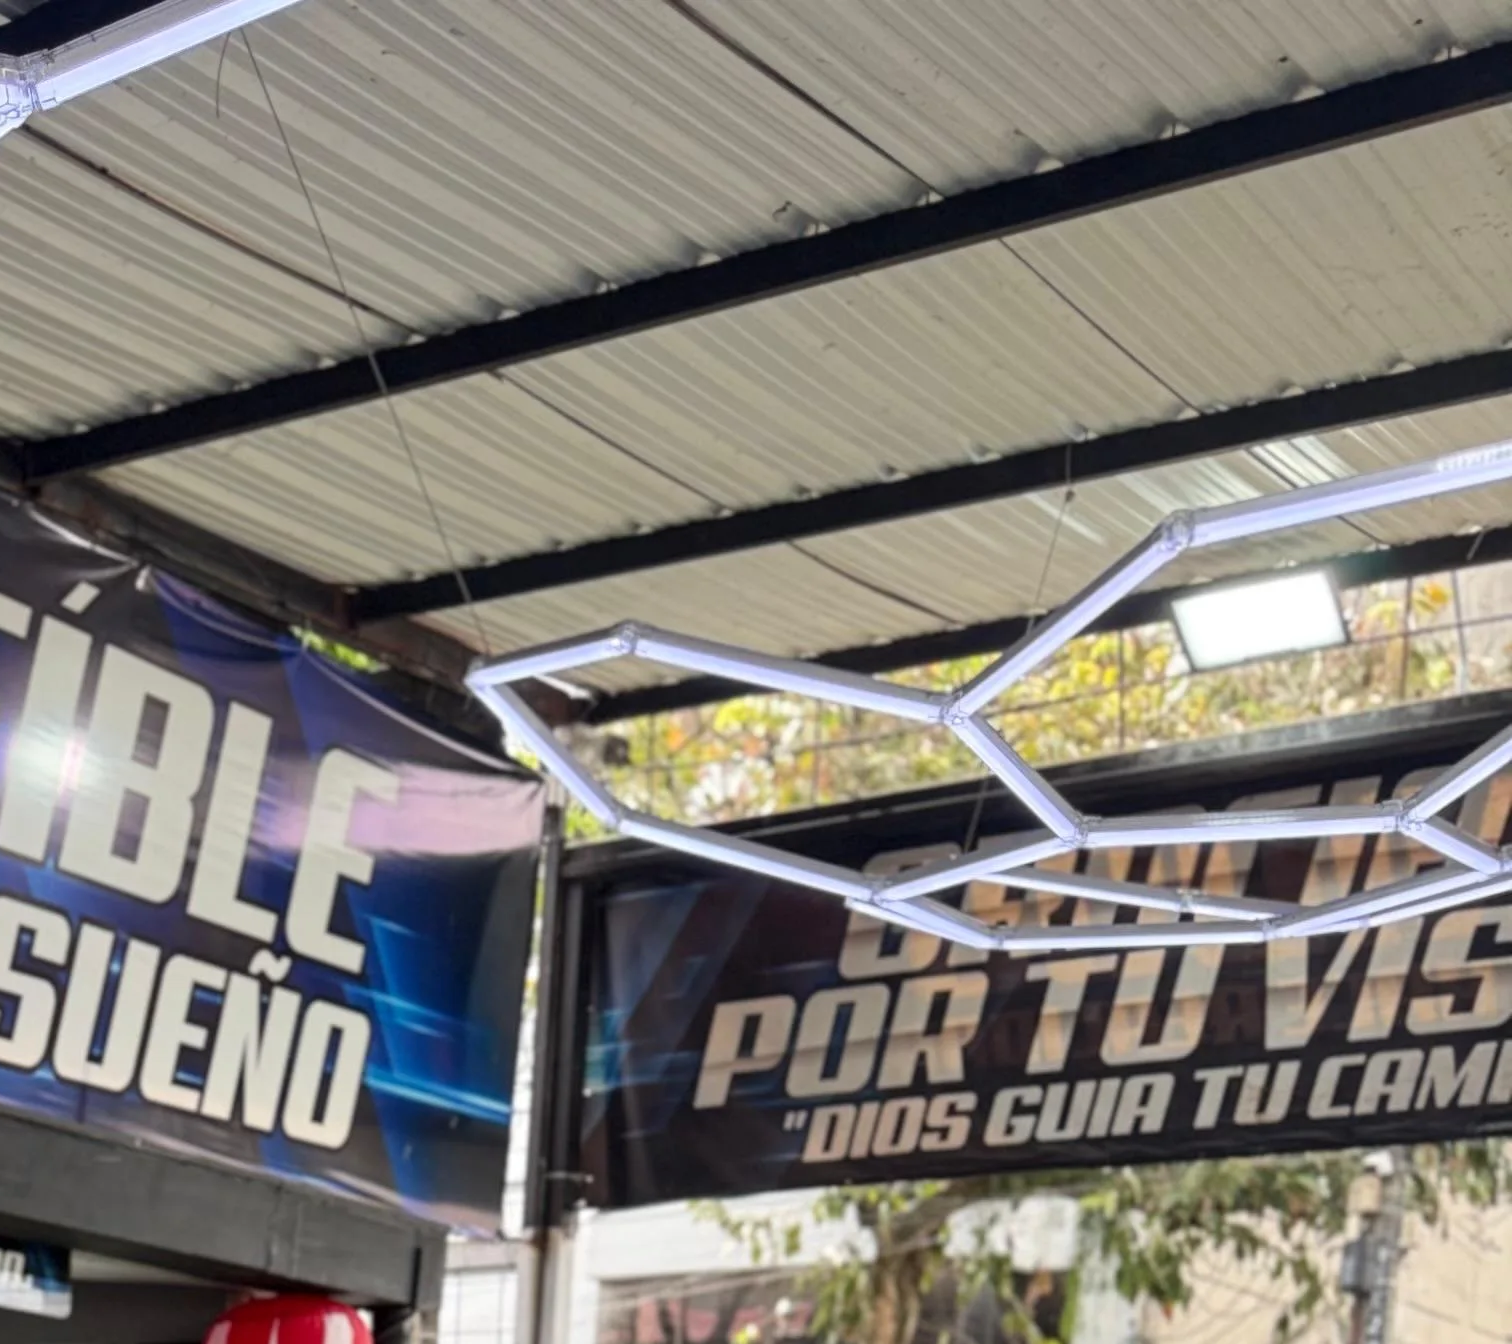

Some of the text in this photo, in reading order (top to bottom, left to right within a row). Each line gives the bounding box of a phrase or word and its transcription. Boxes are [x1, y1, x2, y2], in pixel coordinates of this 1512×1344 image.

[693, 905, 1512, 1110] POR TU VIS
[784, 1089, 978, 1165] "DIOS
[982, 1071, 1176, 1148] GUIA
[1192, 1059, 1301, 1132] TU
